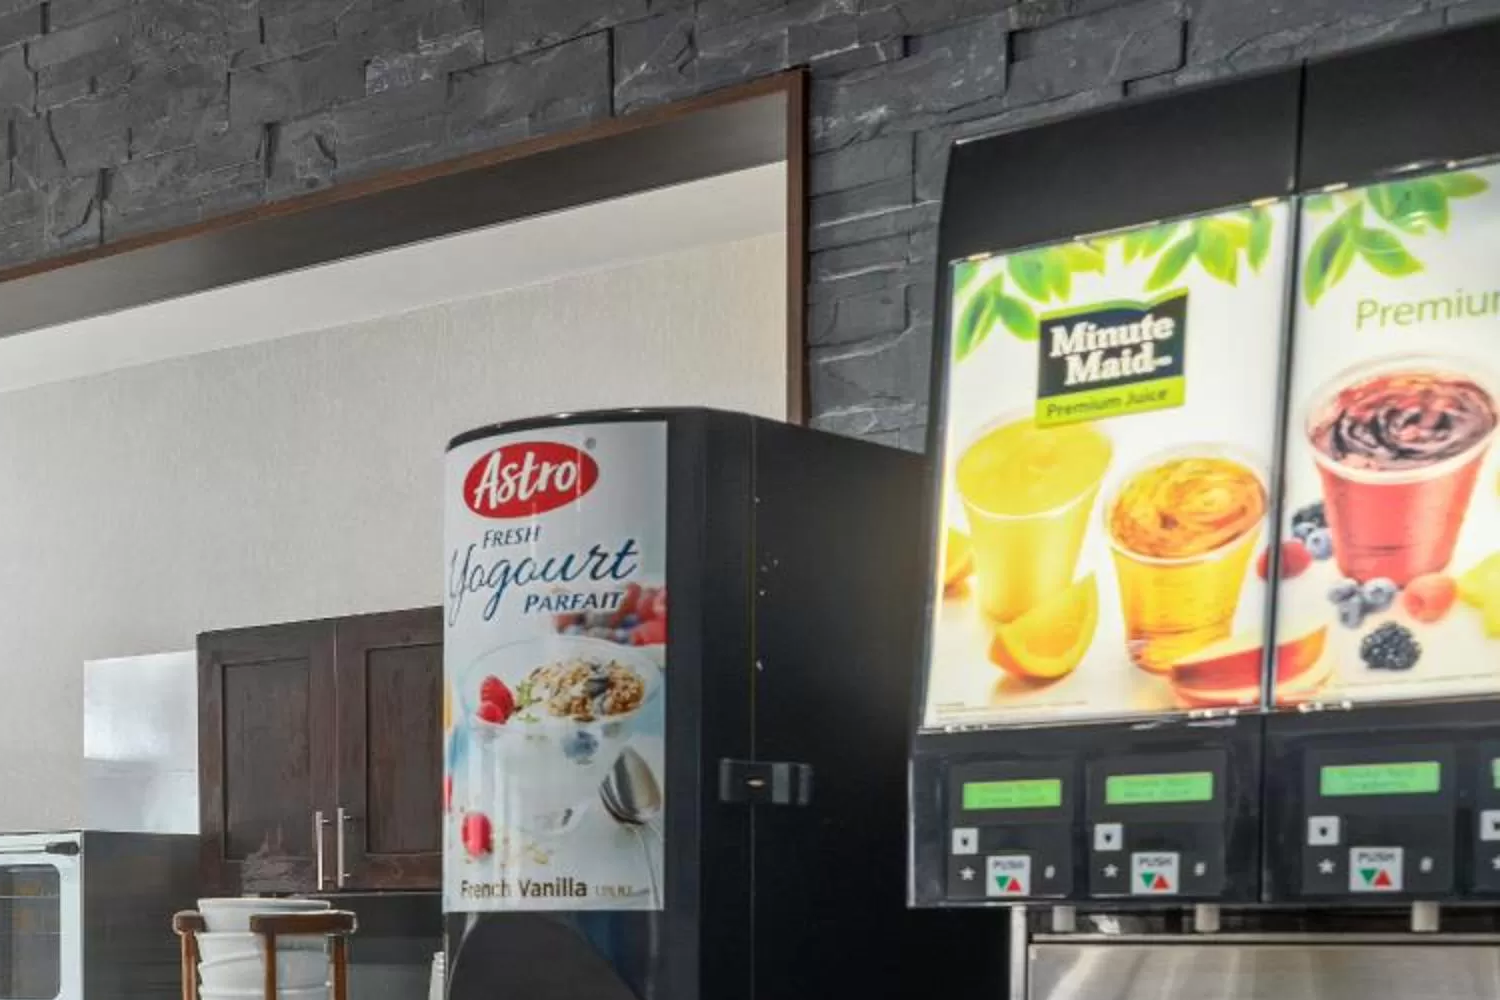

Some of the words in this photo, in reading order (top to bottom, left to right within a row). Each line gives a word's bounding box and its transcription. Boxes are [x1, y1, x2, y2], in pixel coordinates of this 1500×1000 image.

[1356, 287, 1500, 332] Premiu
[1049, 313, 1176, 358] Minute
[1064, 341, 1156, 386] Maid
[1047, 397, 1122, 417] Premium
[1125, 388, 1168, 406] Juice
[473, 451, 577, 510] Astro
[483, 525, 541, 549] FRESH
[449, 539, 638, 628] Yogourt
[524, 591, 624, 614] PARFAIT
[461, 879, 511, 899] French
[518, 878, 587, 898] Vanilla
